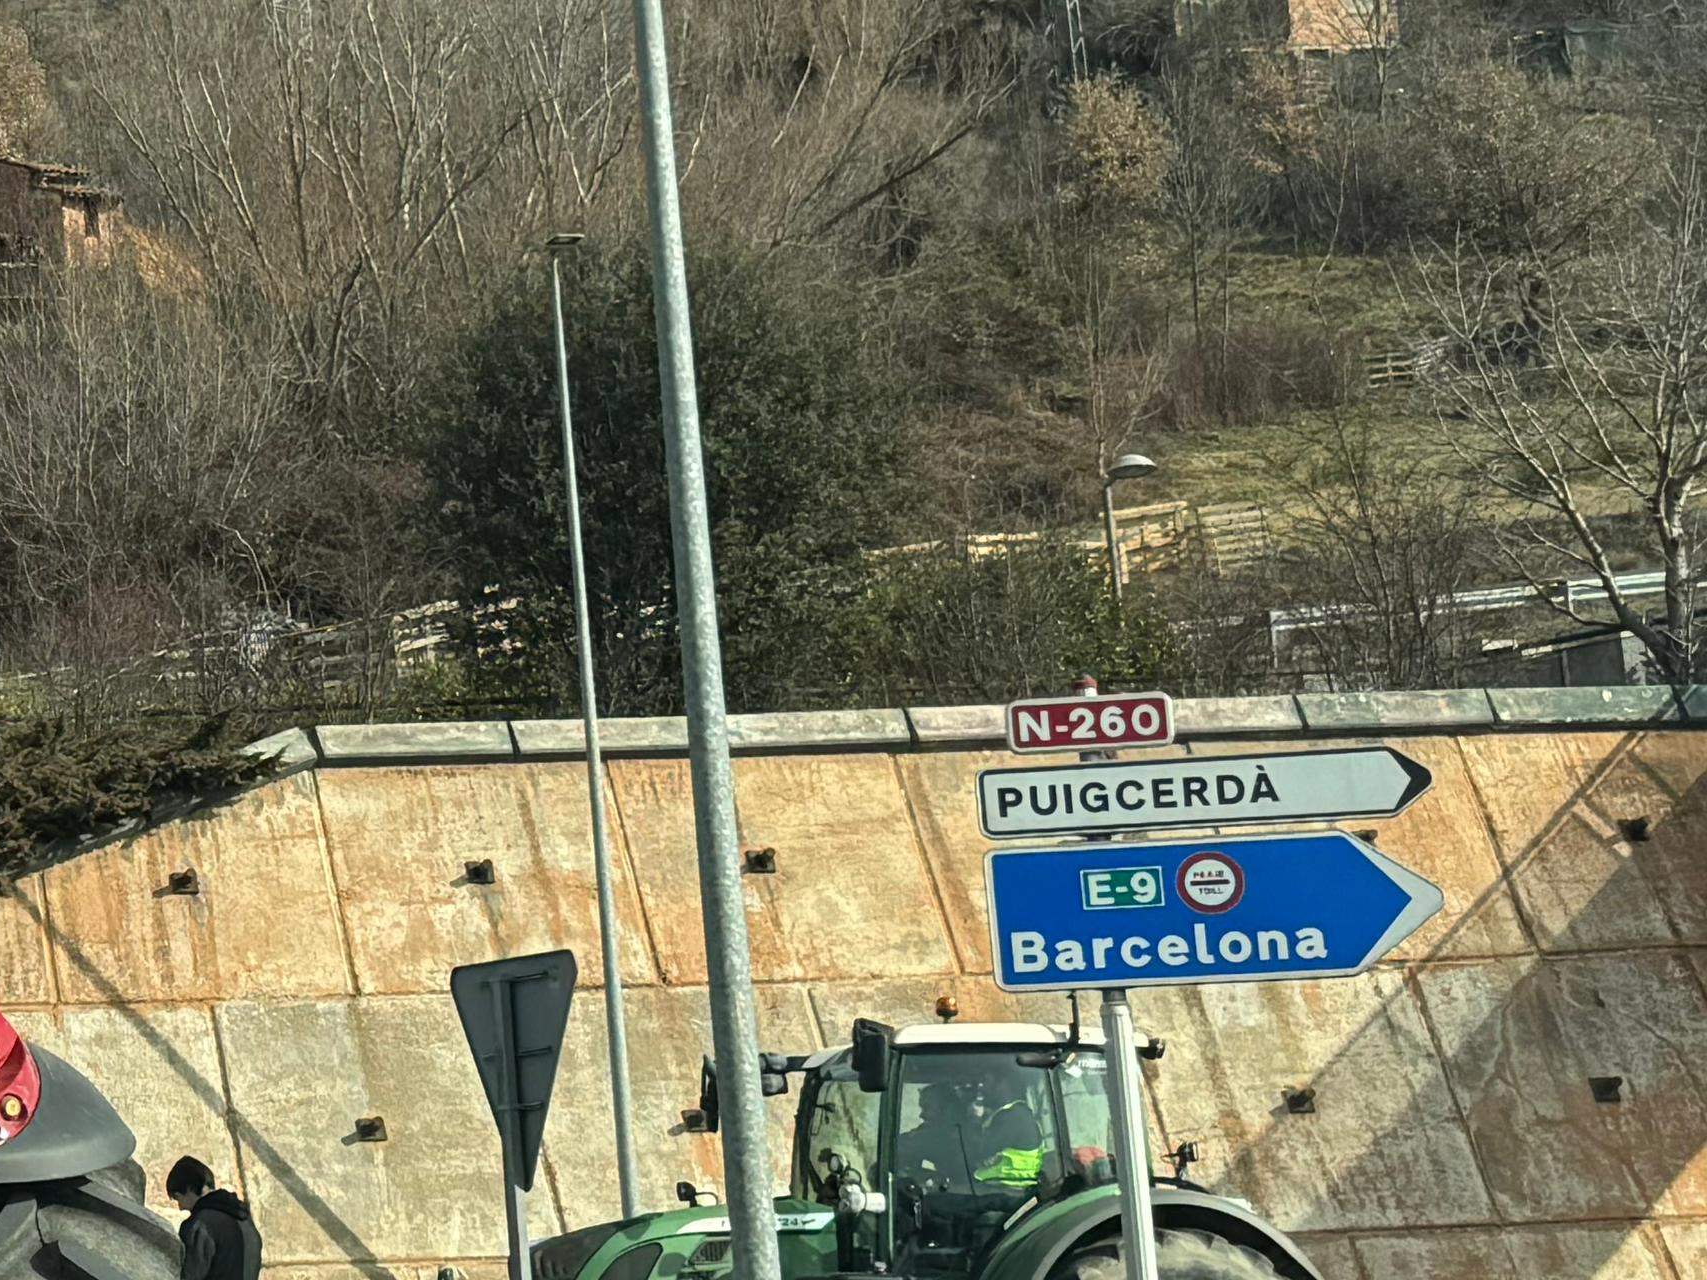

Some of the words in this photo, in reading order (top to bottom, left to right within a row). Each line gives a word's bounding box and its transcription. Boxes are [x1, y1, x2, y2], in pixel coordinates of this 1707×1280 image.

[1017, 703, 1161, 742] N-260
[996, 764, 1281, 818] PUIGCERDÀ
[1087, 871, 1158, 905] E-9
[1010, 923, 1329, 974] Barcelona
